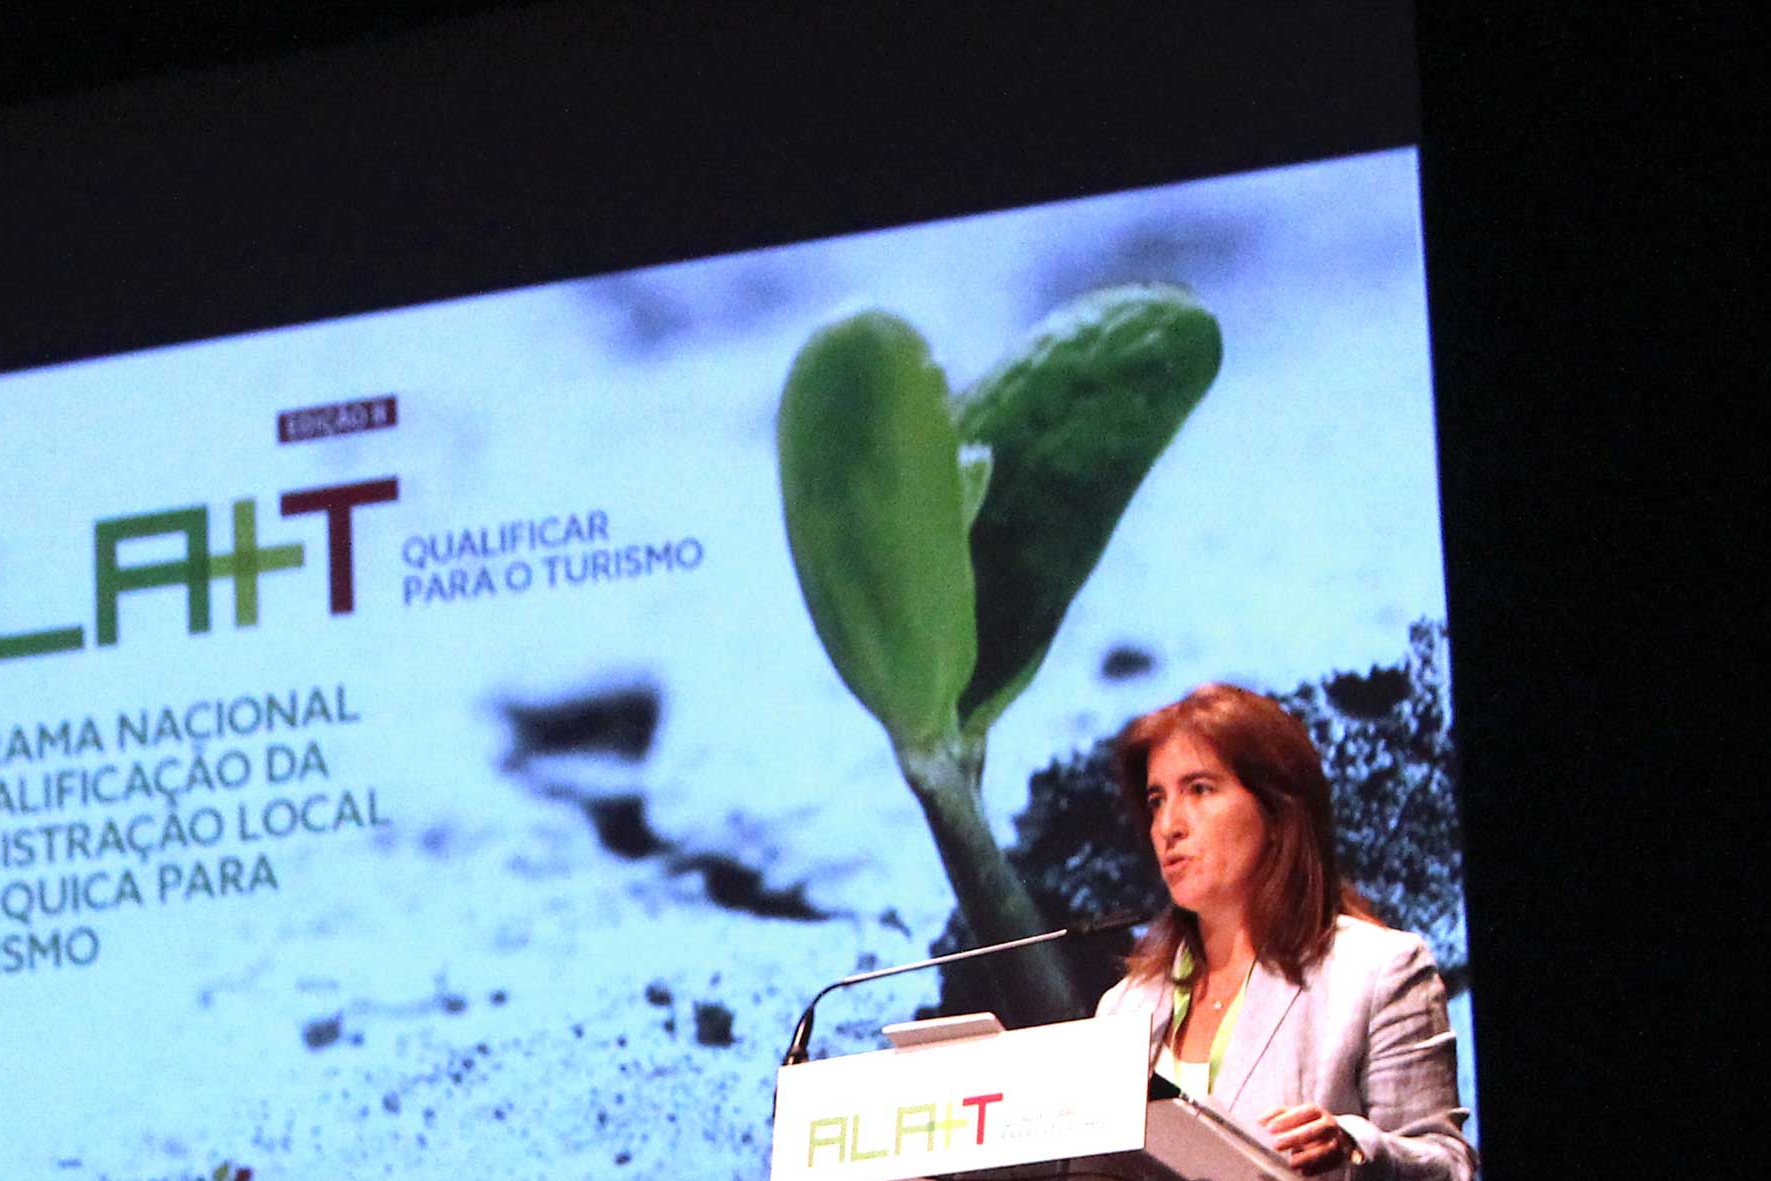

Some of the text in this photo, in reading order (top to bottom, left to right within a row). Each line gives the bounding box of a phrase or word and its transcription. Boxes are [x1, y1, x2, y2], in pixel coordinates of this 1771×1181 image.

[401, 509, 610, 569] QUALIFICAR
[403, 537, 705, 607] PARA O TURISMO
[116, 682, 361, 752] NACIONAL
[265, 740, 330, 785] DA
[238, 787, 391, 843] LOCAL
[157, 852, 280, 905] PARA
